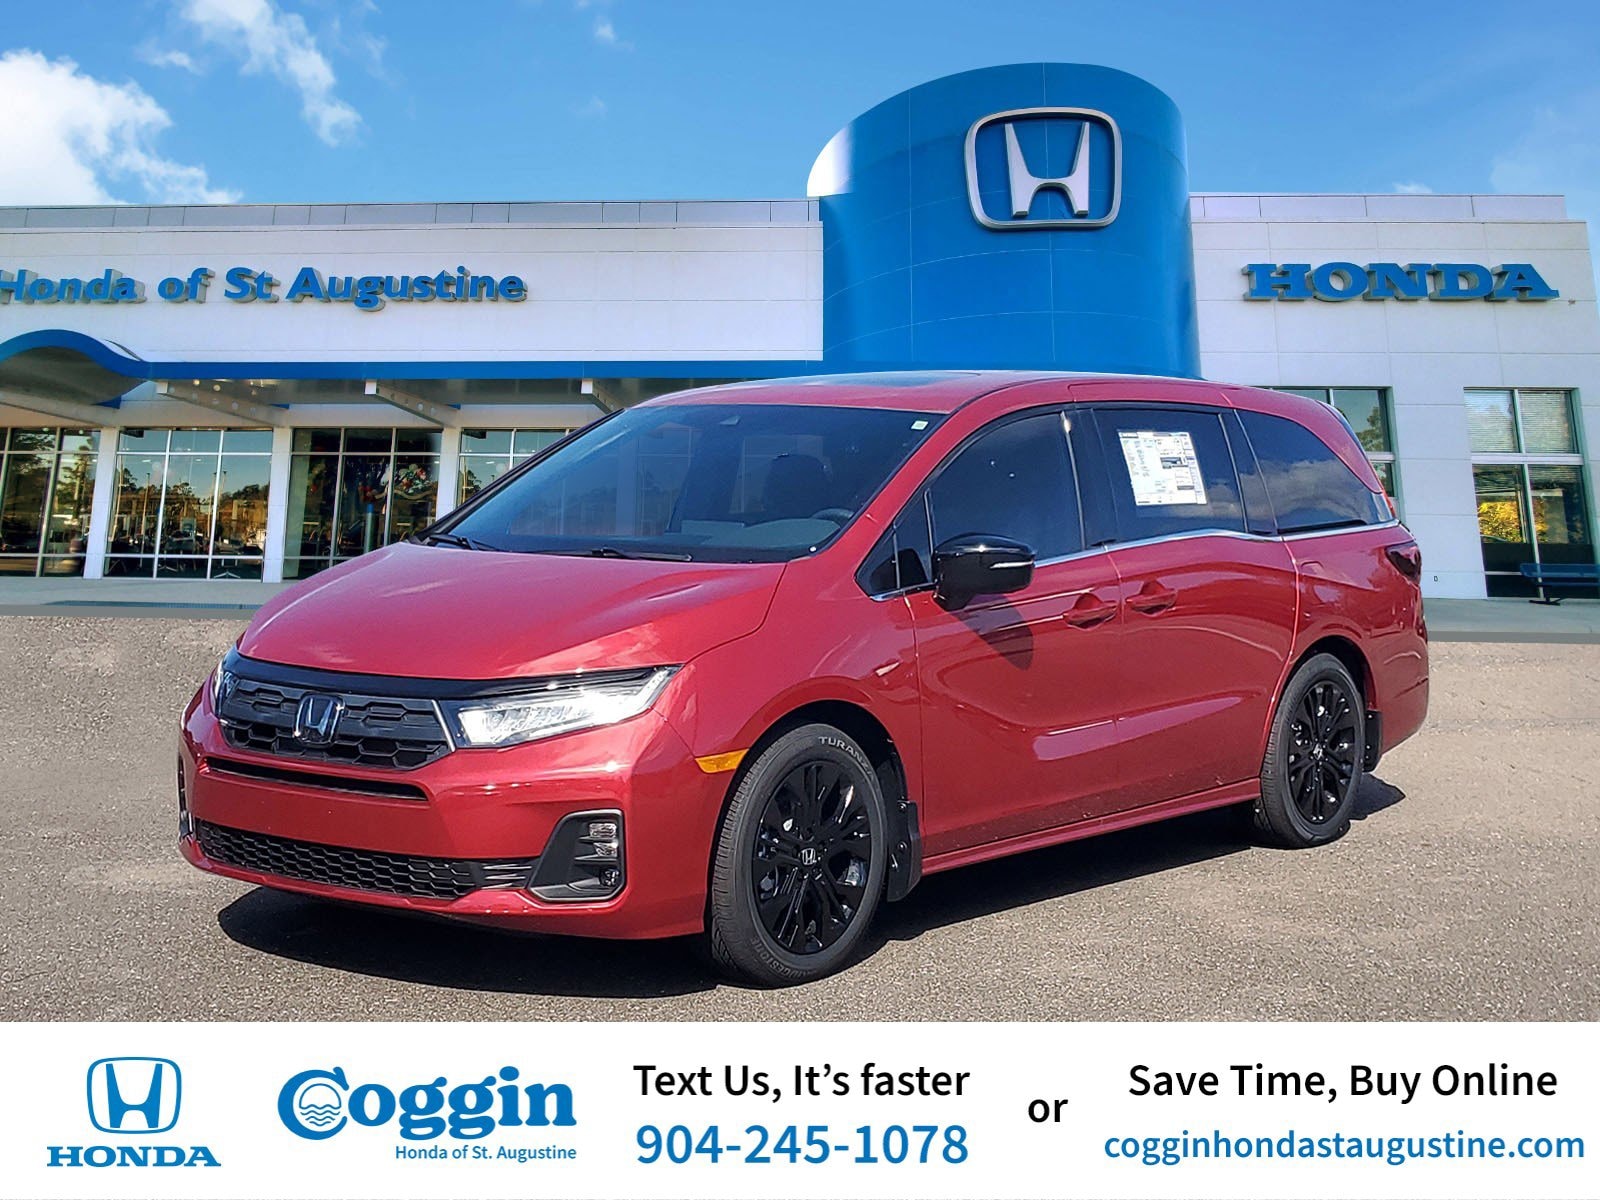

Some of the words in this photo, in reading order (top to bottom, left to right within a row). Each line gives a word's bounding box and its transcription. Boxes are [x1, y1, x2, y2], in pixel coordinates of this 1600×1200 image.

[0, 267, 142, 302] Honda
[157, 266, 211, 302] of
[224, 266, 277, 302] St
[285, 264, 527, 311] Augustine
[1243, 261, 1560, 301] HONDA
